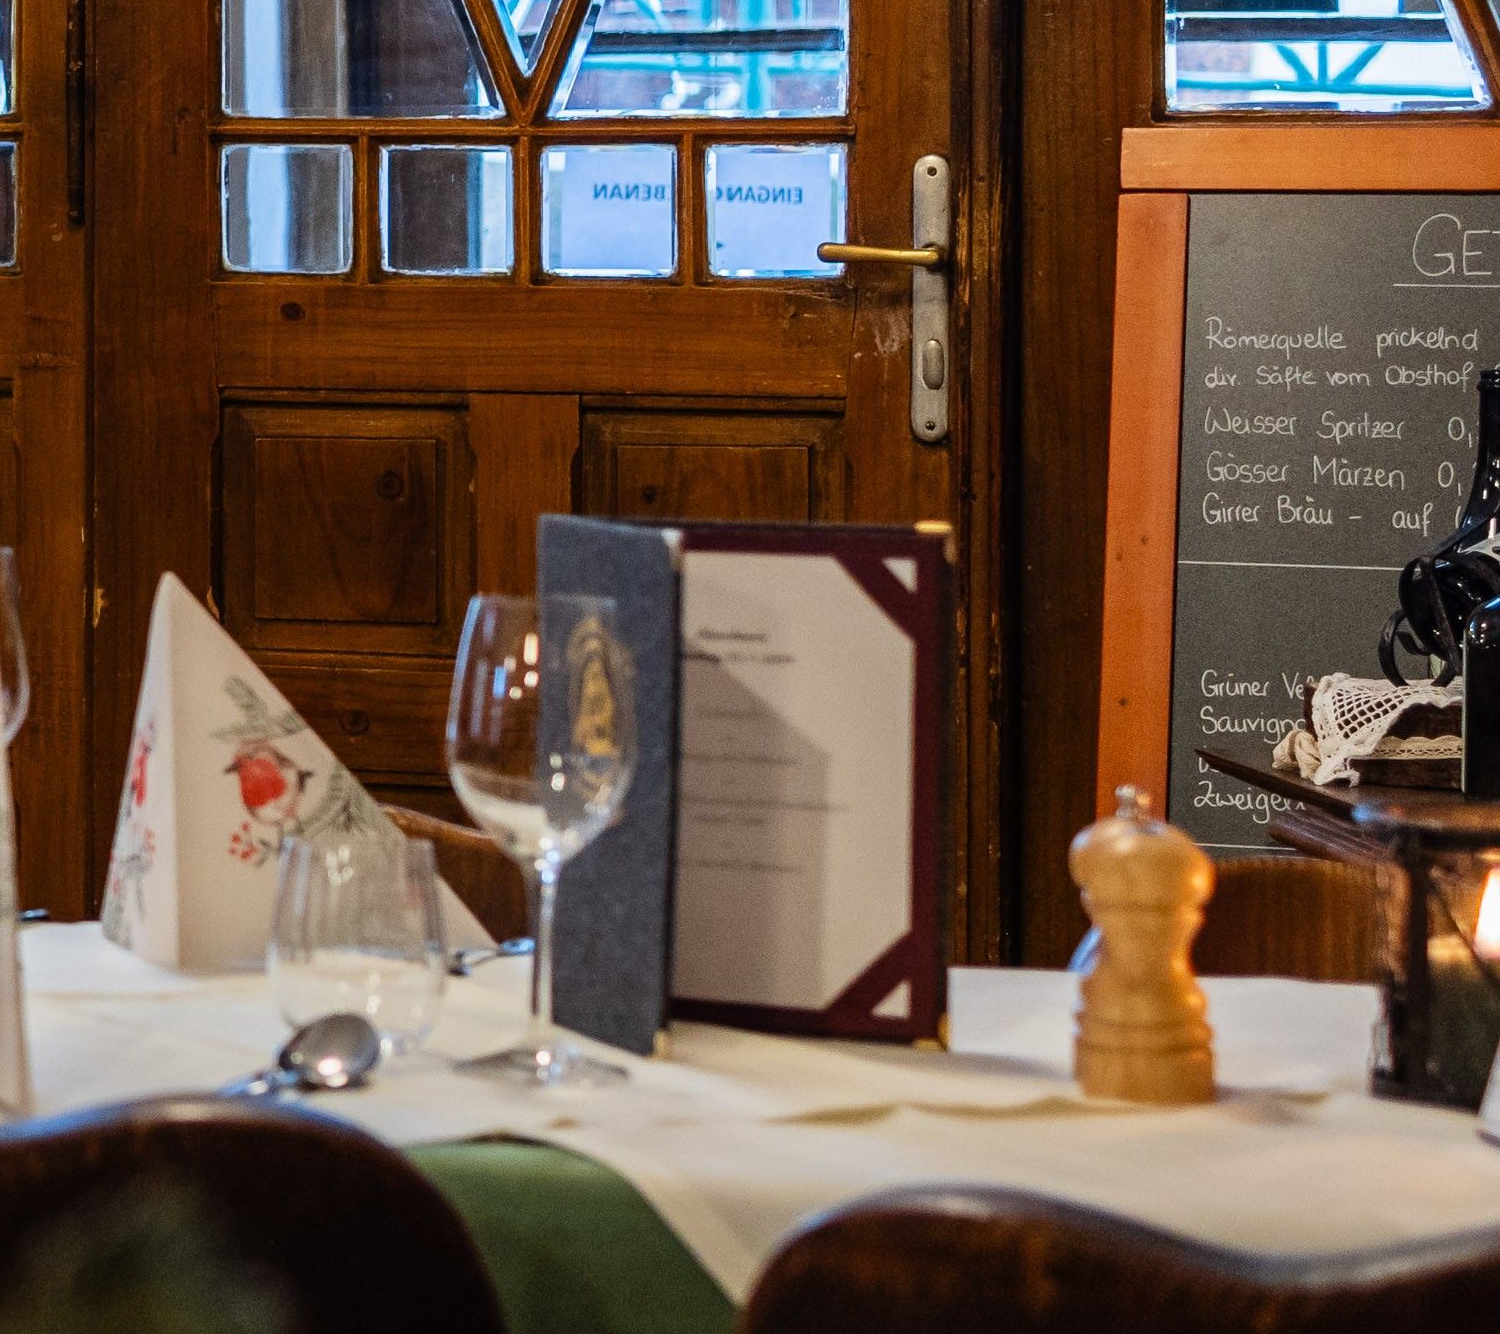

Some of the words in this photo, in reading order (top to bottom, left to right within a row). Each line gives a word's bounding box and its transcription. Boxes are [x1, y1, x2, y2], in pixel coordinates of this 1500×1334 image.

[1412, 213, 1500, 277] GE
[1205, 316, 1346, 359] Römerquelle
[1376, 326, 1479, 358] prickelnd
[1256, 365, 1317, 392] Säfte
[1326, 370, 1371, 387] vom
[1385, 361, 1474, 392] Obsthof
[1204, 407, 1297, 436] Weisser
[1316, 410, 1405, 445] Spritzer
[1207, 451, 1290, 484] Gösser
[1313, 455, 1405, 491] Märzen
[1277, 495, 1334, 526] Bräu
[1392, 502, 1433, 537] auf
[1201, 669, 1270, 699] Grüner
